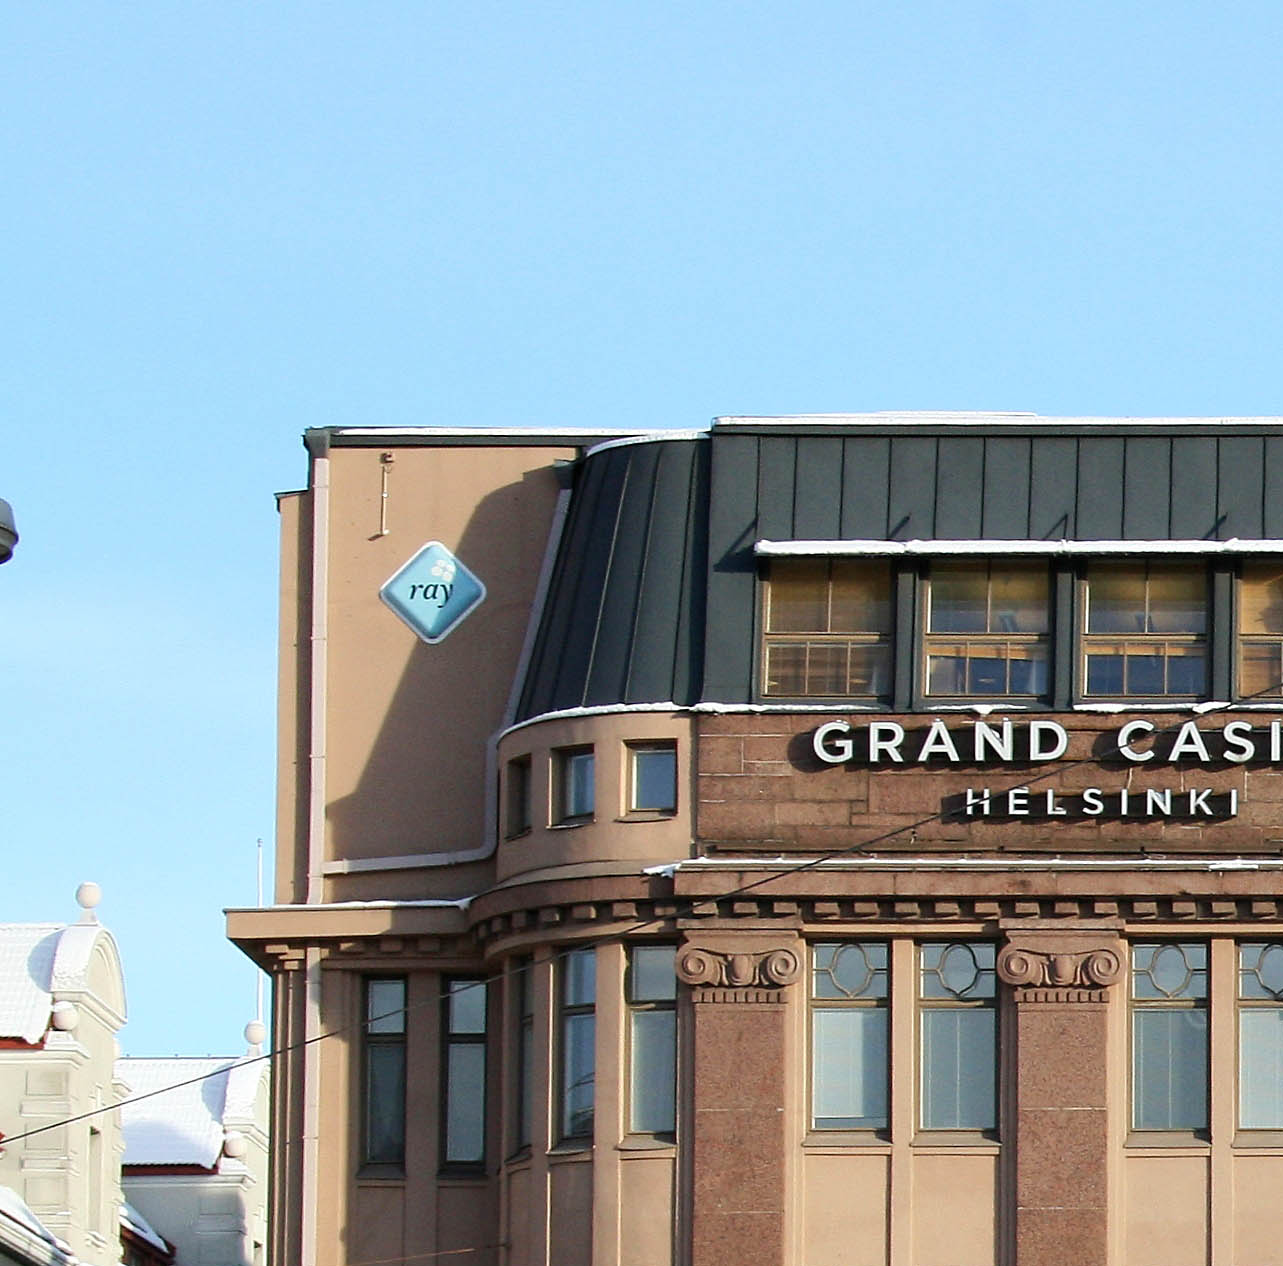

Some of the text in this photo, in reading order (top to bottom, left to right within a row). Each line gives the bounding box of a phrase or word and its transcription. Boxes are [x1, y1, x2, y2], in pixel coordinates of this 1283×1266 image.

[408, 582, 454, 609] ray
[812, 718, 1068, 763] GRAND
[966, 787, 1238, 816] HELSINKI
